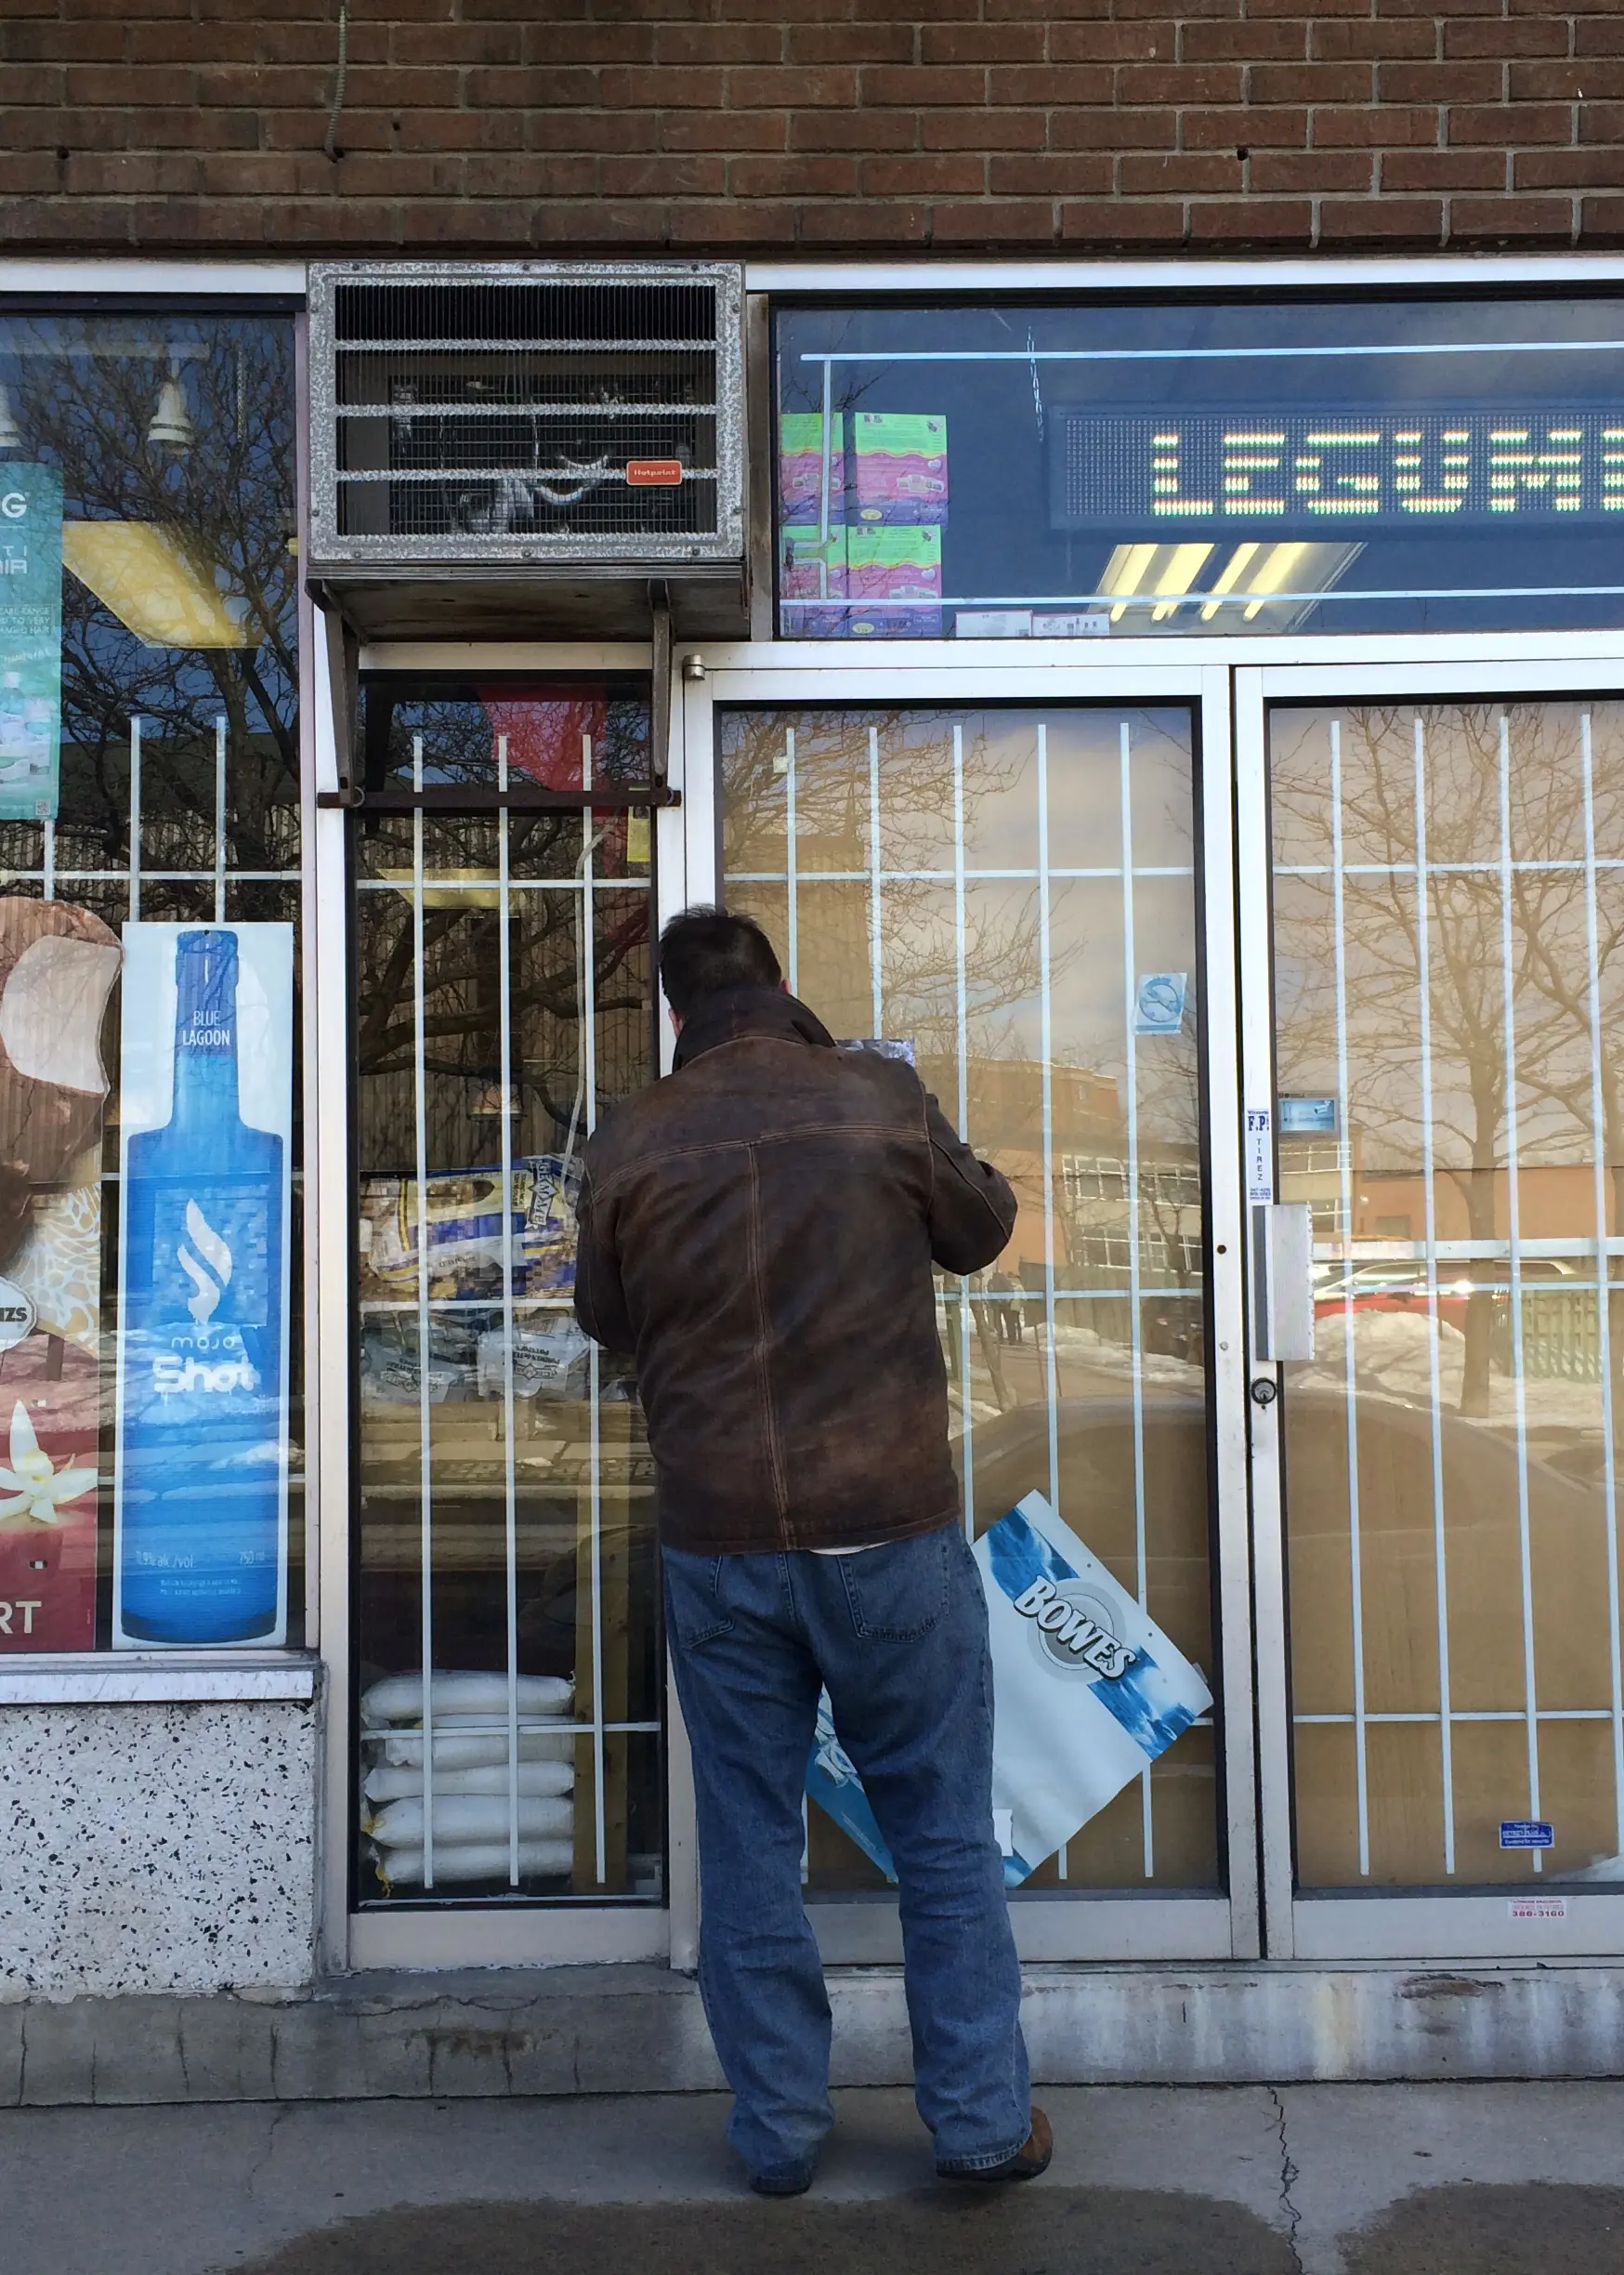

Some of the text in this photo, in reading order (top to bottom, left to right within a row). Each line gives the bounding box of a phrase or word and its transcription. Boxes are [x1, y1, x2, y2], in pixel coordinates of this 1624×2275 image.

[193, 1010, 221, 1026] BLUE
[182, 1030, 230, 1045] LAGOON
[152, 1354, 255, 1393] Shot
[0, 1600, 42, 1634] RT
[1014, 1574, 1136, 1680] BOWES
